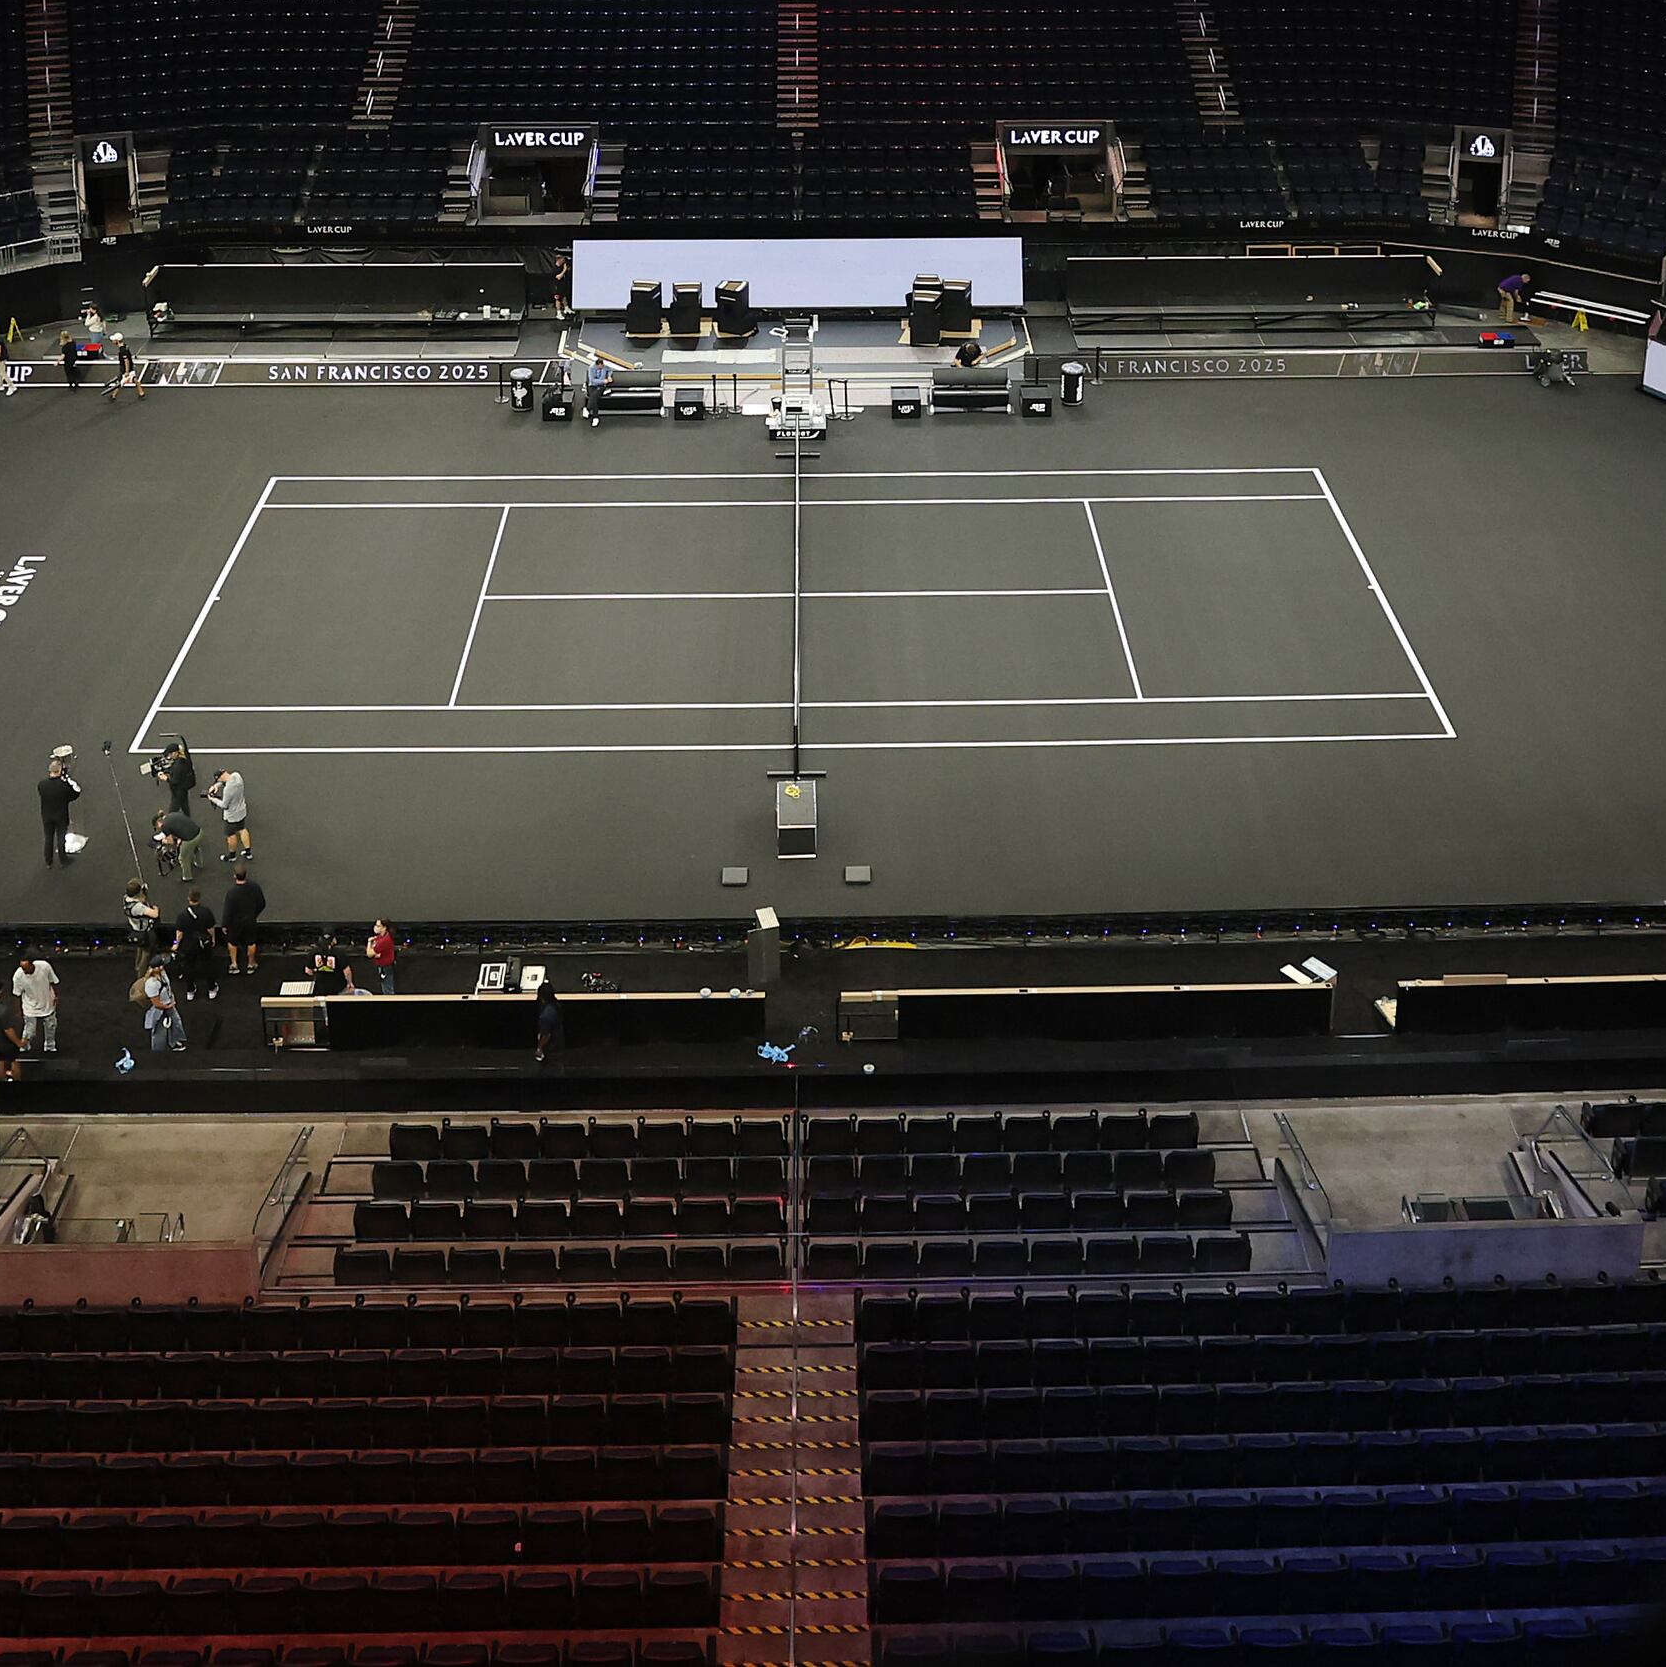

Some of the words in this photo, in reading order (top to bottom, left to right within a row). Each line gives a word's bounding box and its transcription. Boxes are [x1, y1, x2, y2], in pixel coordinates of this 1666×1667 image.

[494, 130, 547, 148] LAVER
[549, 130, 585, 147] CUP
[1010, 129, 1063, 145] LAVER
[1064, 129, 1101, 145] CUP
[307, 225, 334, 234] LAVER
[334, 225, 352, 234] CUP
[1239, 220, 1267, 229] LAVER
[1267, 221, 1285, 229] CUP
[1471, 228, 1499, 239] LAVER
[1499, 230, 1519, 240] CUP
[268, 364, 310, 381] SAN
[317, 364, 434, 381] FRANCISCO
[439, 364, 490, 381] 2025
[1117, 359, 1230, 374] FRANCISCO
[1238, 358, 1287, 374] 2025
